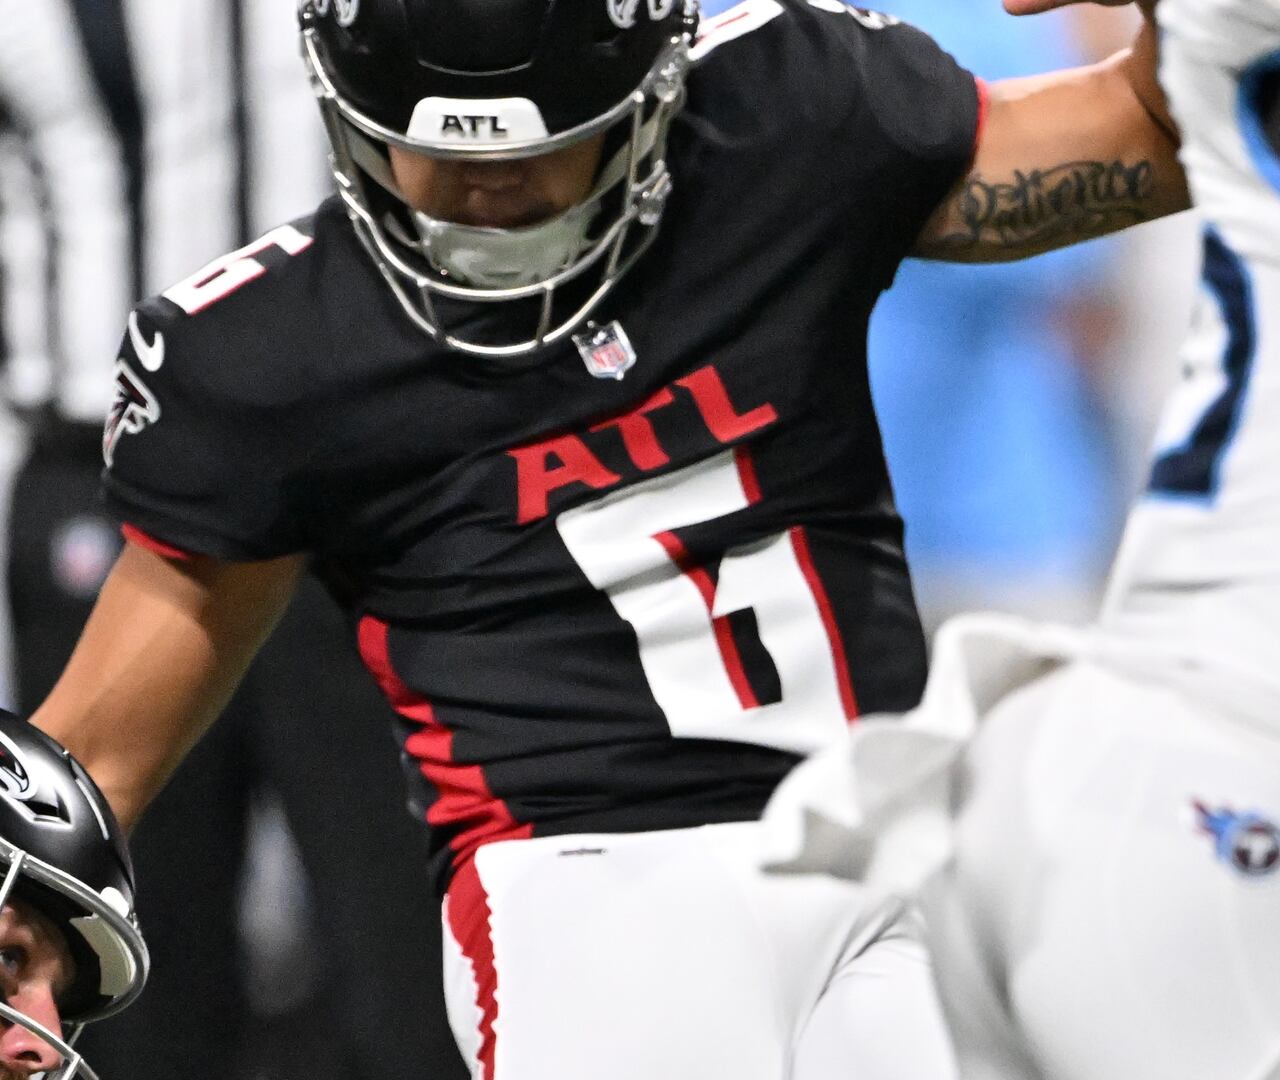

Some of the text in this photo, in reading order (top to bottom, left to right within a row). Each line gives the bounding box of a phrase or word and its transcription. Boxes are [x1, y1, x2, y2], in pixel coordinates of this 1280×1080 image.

[441, 114, 508, 136] ATL
[160, 223, 314, 316] 6
[506, 365, 779, 526] ATL
[555, 446, 859, 760] 6
